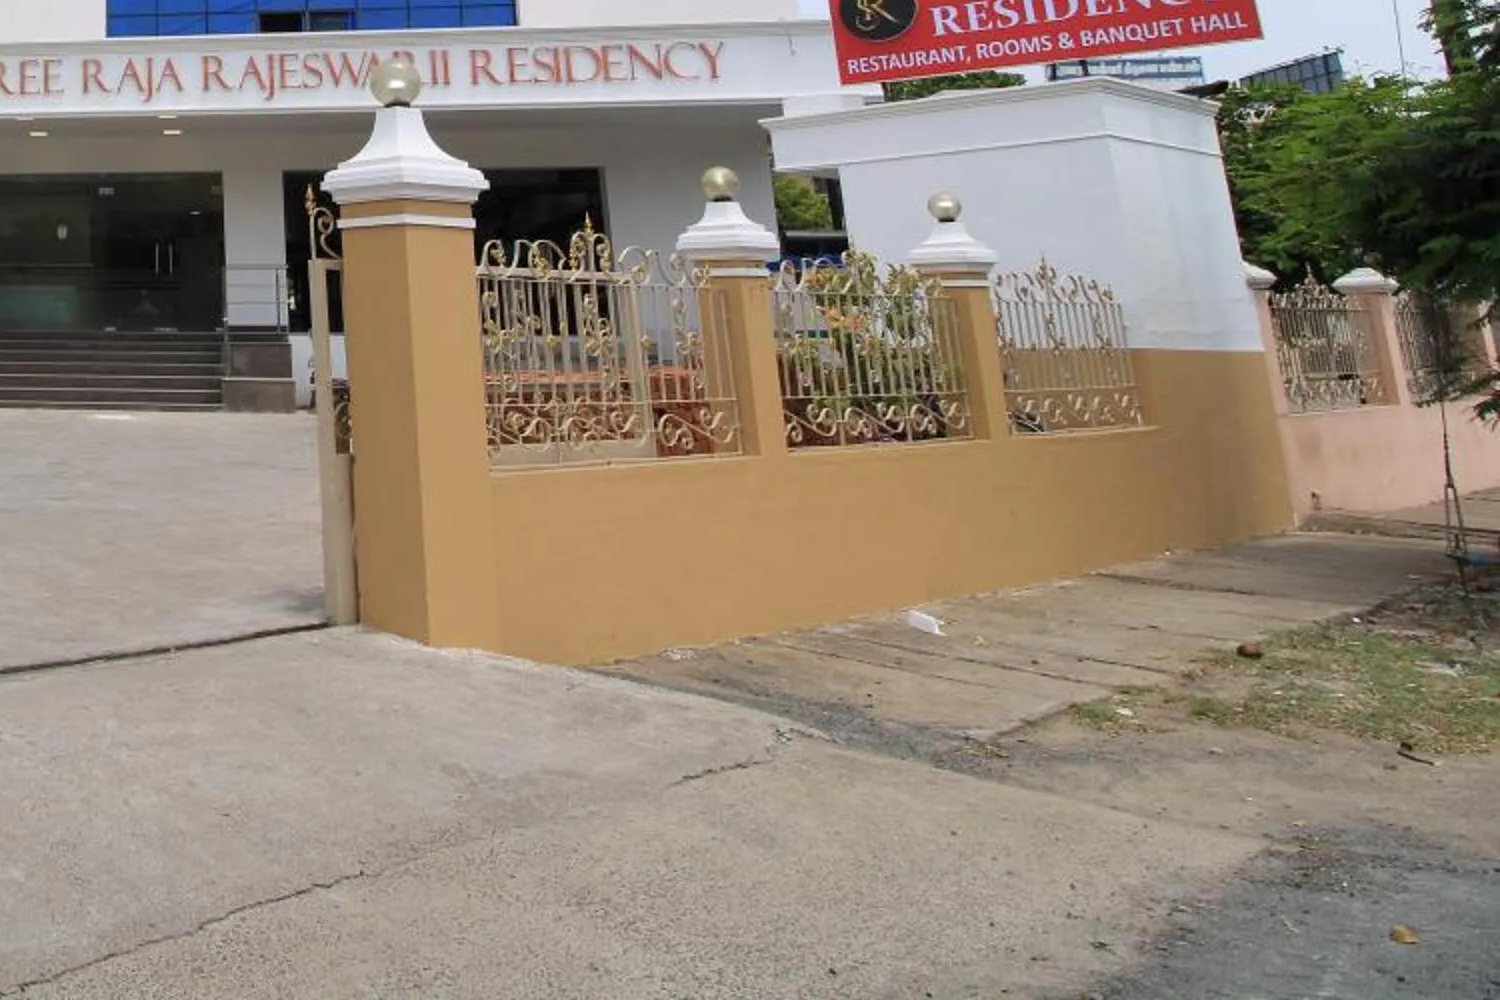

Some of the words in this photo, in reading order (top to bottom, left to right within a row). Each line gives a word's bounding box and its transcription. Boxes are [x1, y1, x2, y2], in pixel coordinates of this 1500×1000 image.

[81, 55, 184, 103] RAJA
[467, 41, 725, 87] RESIDENCY
[847, 44, 972, 75] RESTAURANT,
[975, 33, 1053, 58] ROOMS
[1058, 31, 1076, 50] &
[1081, 18, 1184, 47] BANQUET
[1191, 11, 1249, 33] HALL
